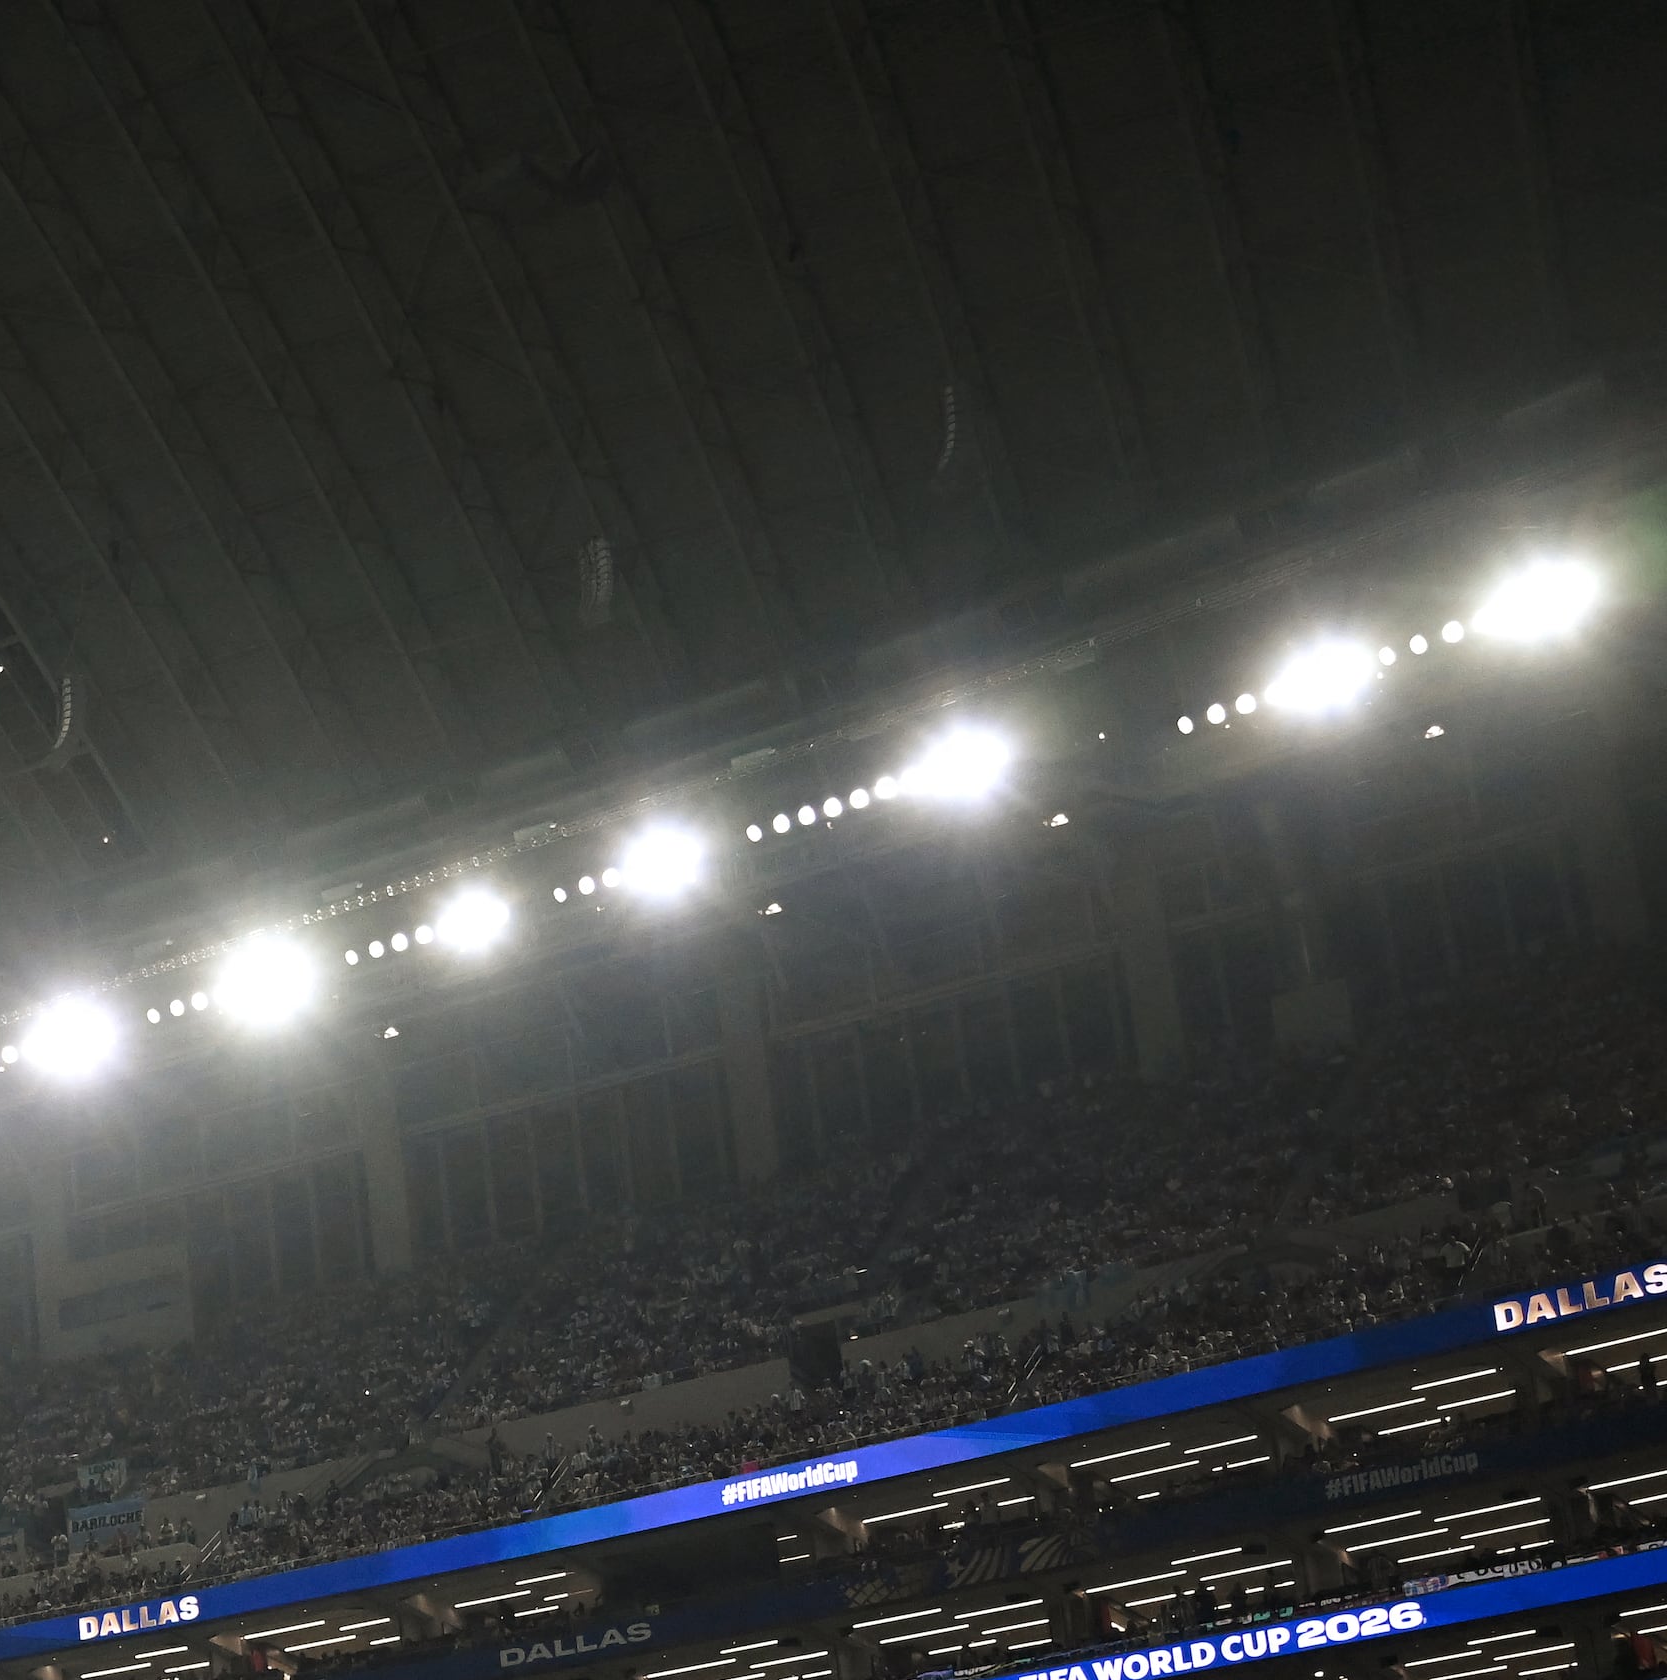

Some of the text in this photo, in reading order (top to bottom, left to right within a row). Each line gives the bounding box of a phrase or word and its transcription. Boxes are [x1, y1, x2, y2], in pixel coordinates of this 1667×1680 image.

[1493, 1263, 1667, 1332] DALLAS
[721, 1459, 858, 1506] #FIFAWorldCup
[1324, 1451, 1480, 1500] #FIFAWorldCup
[71, 1510, 143, 1533] BARILOCHE
[78, 1595, 199, 1640] DALLAS
[1220, 1626, 1291, 1663] CUP
[1294, 1600, 1422, 1650] 2026
[499, 1622, 651, 1668] DALLAS
